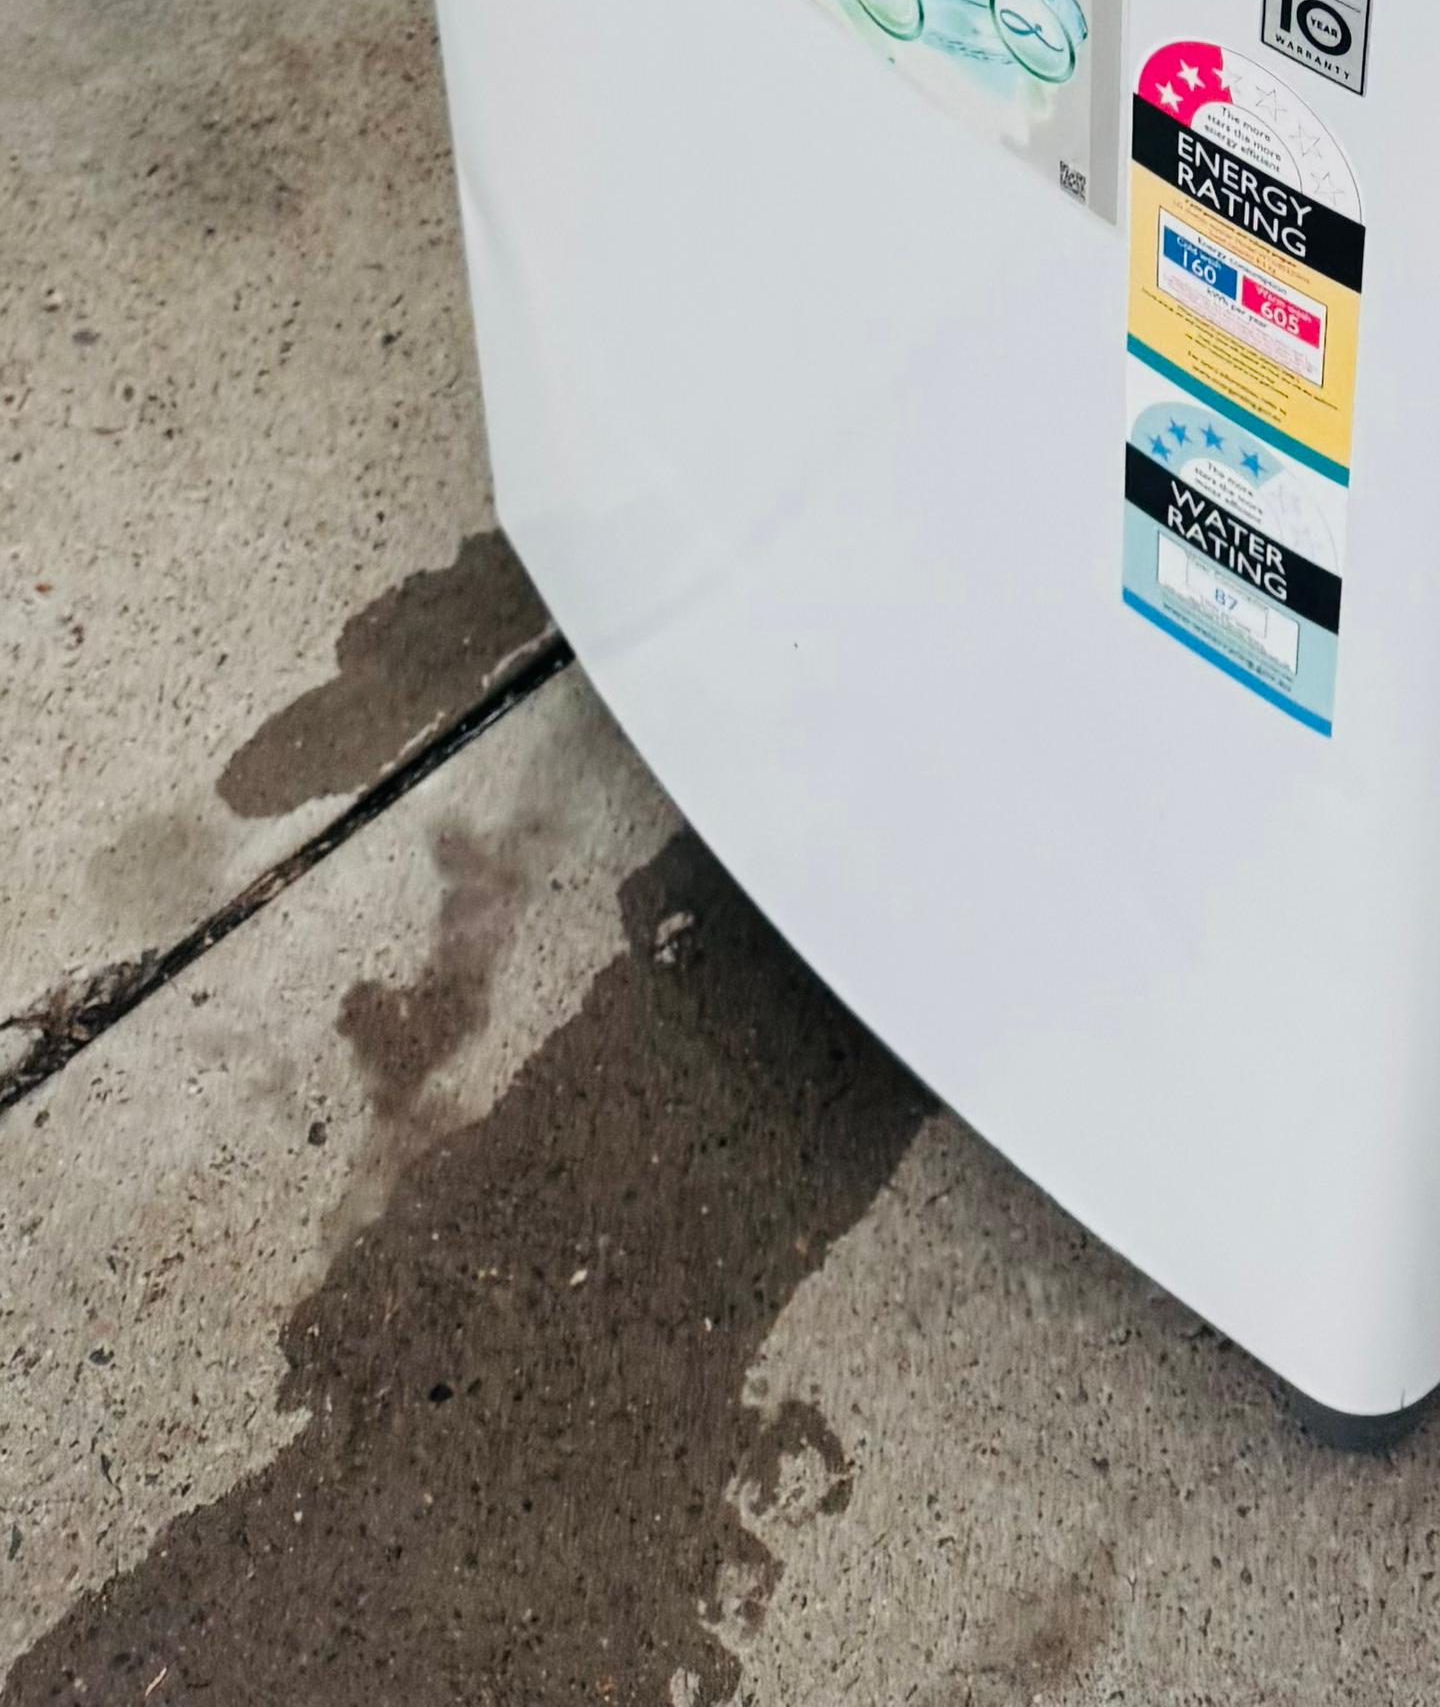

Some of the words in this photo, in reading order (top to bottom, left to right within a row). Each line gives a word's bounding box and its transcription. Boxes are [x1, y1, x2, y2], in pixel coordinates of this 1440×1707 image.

[1310, 16, 1338, 39] YEAR
[1275, 34, 1350, 81] WARRANTY
[1207, 114, 1231, 133] stars
[1233, 128, 1251, 144] the
[1253, 141, 1282, 162] more
[1222, 107, 1240, 124] The
[1243, 121, 1271, 143] more
[1204, 124, 1238, 150] energy
[1240, 145, 1281, 174] efficient
[1178, 130, 1313, 227] ENERGY
[1177, 160, 1308, 258] RATING
[1181, 249, 1218, 286] 160
[1197, 236, 1227, 261] Energy
[1260, 301, 1301, 335] 605
[1170, 479, 1287, 576] WATER
[1167, 504, 1288, 603] RATING
